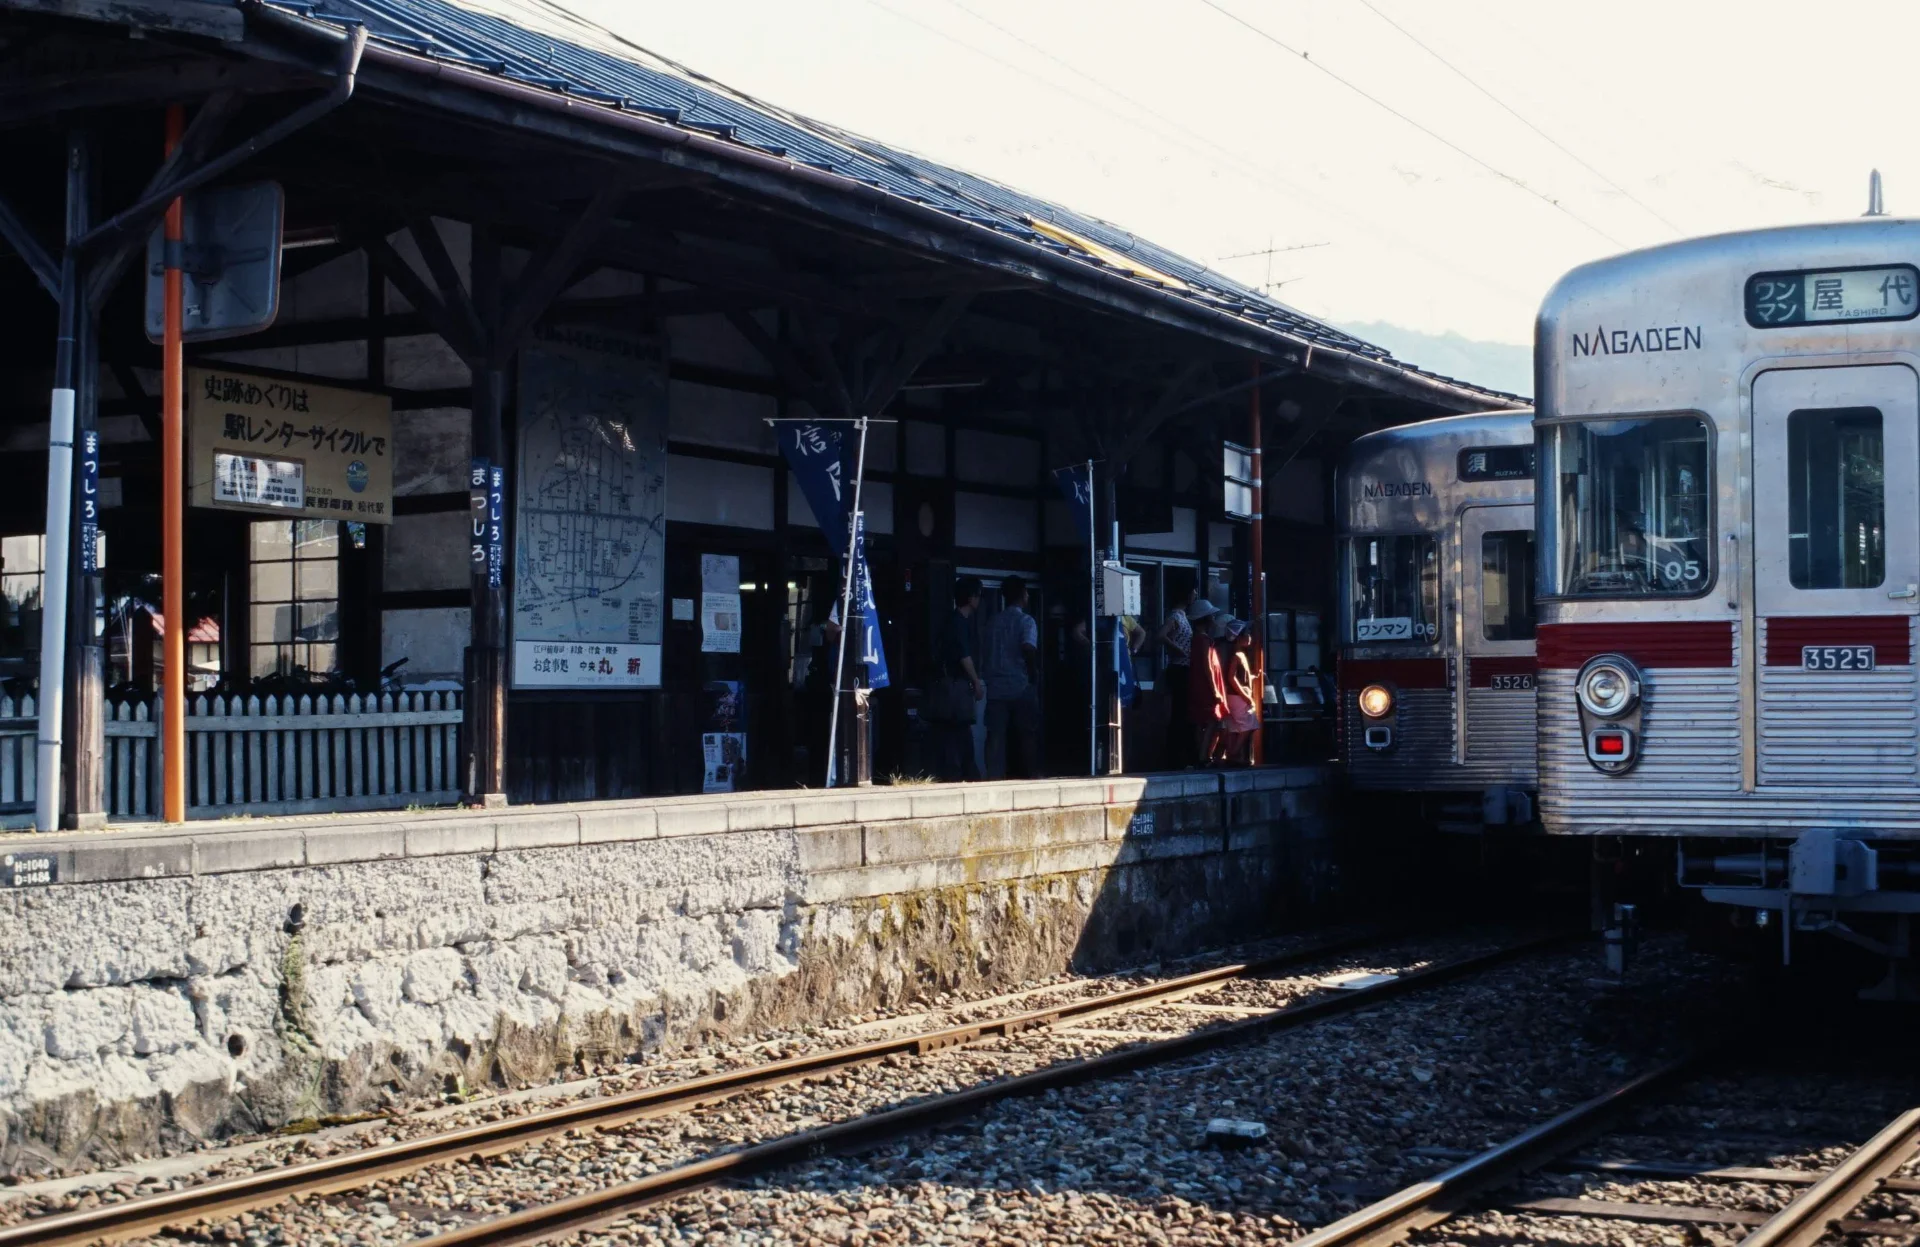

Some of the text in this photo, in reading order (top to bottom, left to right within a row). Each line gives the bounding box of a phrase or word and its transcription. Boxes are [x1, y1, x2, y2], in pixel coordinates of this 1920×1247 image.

[1755, 281, 1797, 302] ワン
[1811, 275, 1912, 311] 屋代
[1756, 302, 1799, 322] マン
[1837, 307, 1888, 318] YASHIRO
[1572, 324, 1701, 357] NAGADEN
[204, 375, 310, 413] 史跡めぐりは
[223, 413, 386, 457] 駅レンターサイクルで
[84, 436, 97, 519] まつしろ
[1494, 470, 1524, 478] SUZAKA
[1364, 481, 1432, 497] NAGADEN
[471, 467, 487, 562] まつしろ
[491, 472, 501, 541] まつしろ
[856, 518, 864, 576] まつしろ
[1664, 559, 1700, 581] 05
[1358, 624, 1408, 637] ワンマン
[1415, 622, 1436, 636] 06
[533, 658, 569, 673] お食事処
[1805, 648, 1871, 670] 3525
[1493, 676, 1531, 689] 3526
